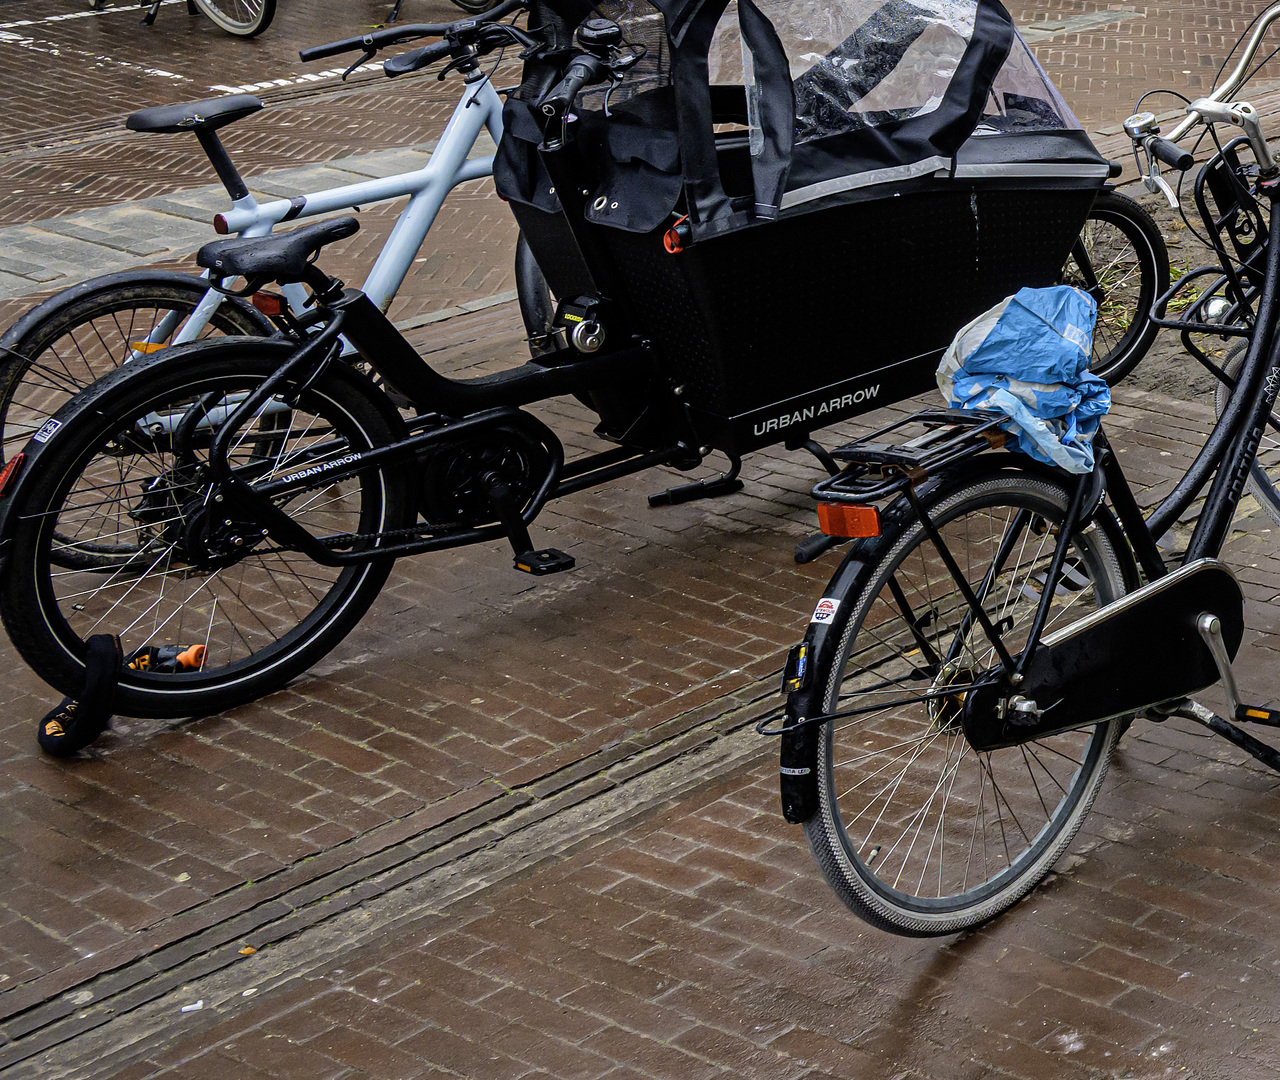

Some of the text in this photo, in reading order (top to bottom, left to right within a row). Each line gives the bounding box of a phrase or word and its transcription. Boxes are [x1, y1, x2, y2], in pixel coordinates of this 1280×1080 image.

[754, 384, 880, 436] URBAN ARROW
[284, 452, 362, 482] URBAN ARROW
